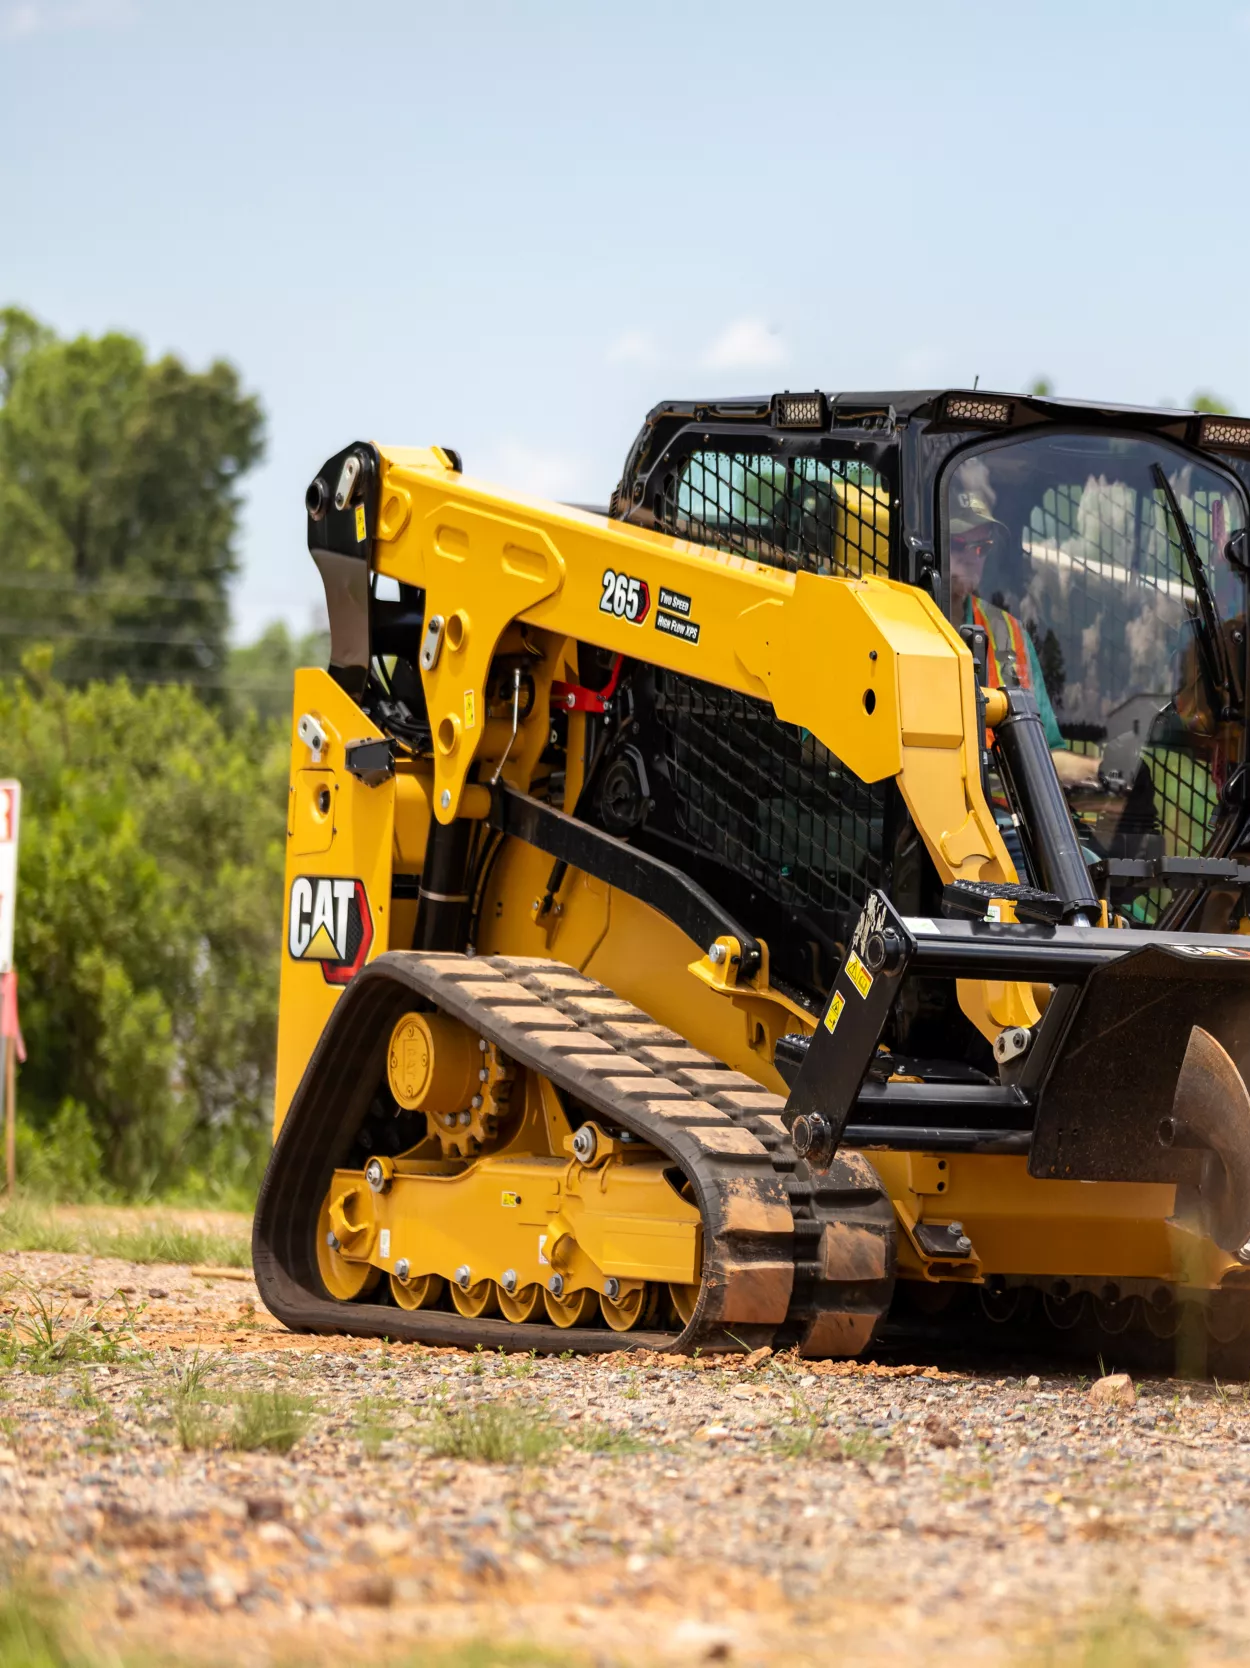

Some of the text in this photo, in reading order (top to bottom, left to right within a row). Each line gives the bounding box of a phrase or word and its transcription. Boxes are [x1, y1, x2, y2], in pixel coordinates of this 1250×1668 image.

[600, 570, 641, 619] 265
[685, 625, 698, 639] XPS
[290, 877, 355, 960] CAT
[1170, 945, 1239, 957] CAT
